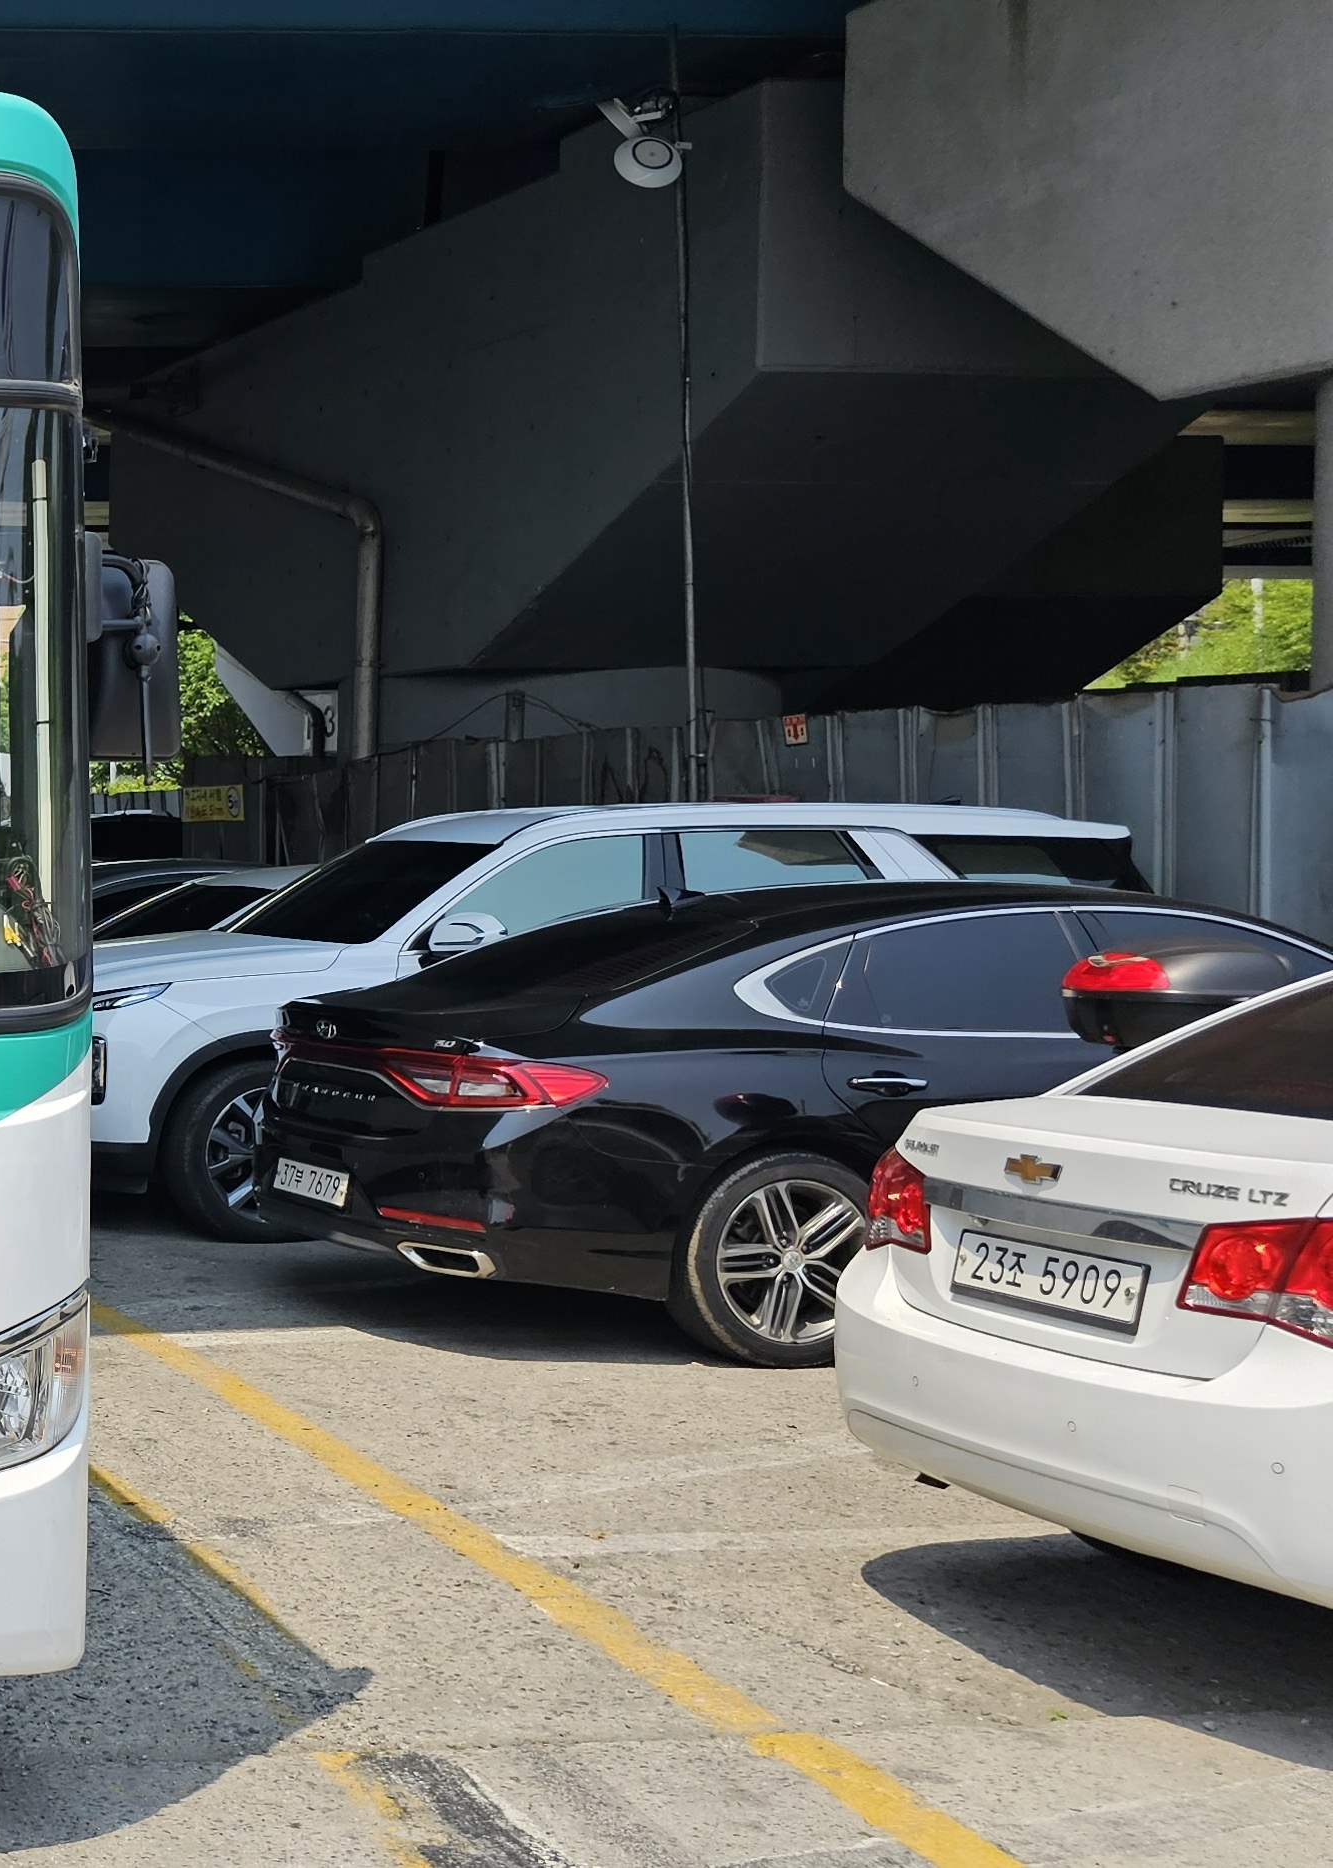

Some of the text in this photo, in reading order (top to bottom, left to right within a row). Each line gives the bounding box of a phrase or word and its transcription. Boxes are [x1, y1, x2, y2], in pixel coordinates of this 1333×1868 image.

[280, 1163, 341, 1199] 37부 7679
[1169, 1177, 1290, 1207] CRUZE LTZ
[970, 1242, 1122, 1309] 23조 5909
